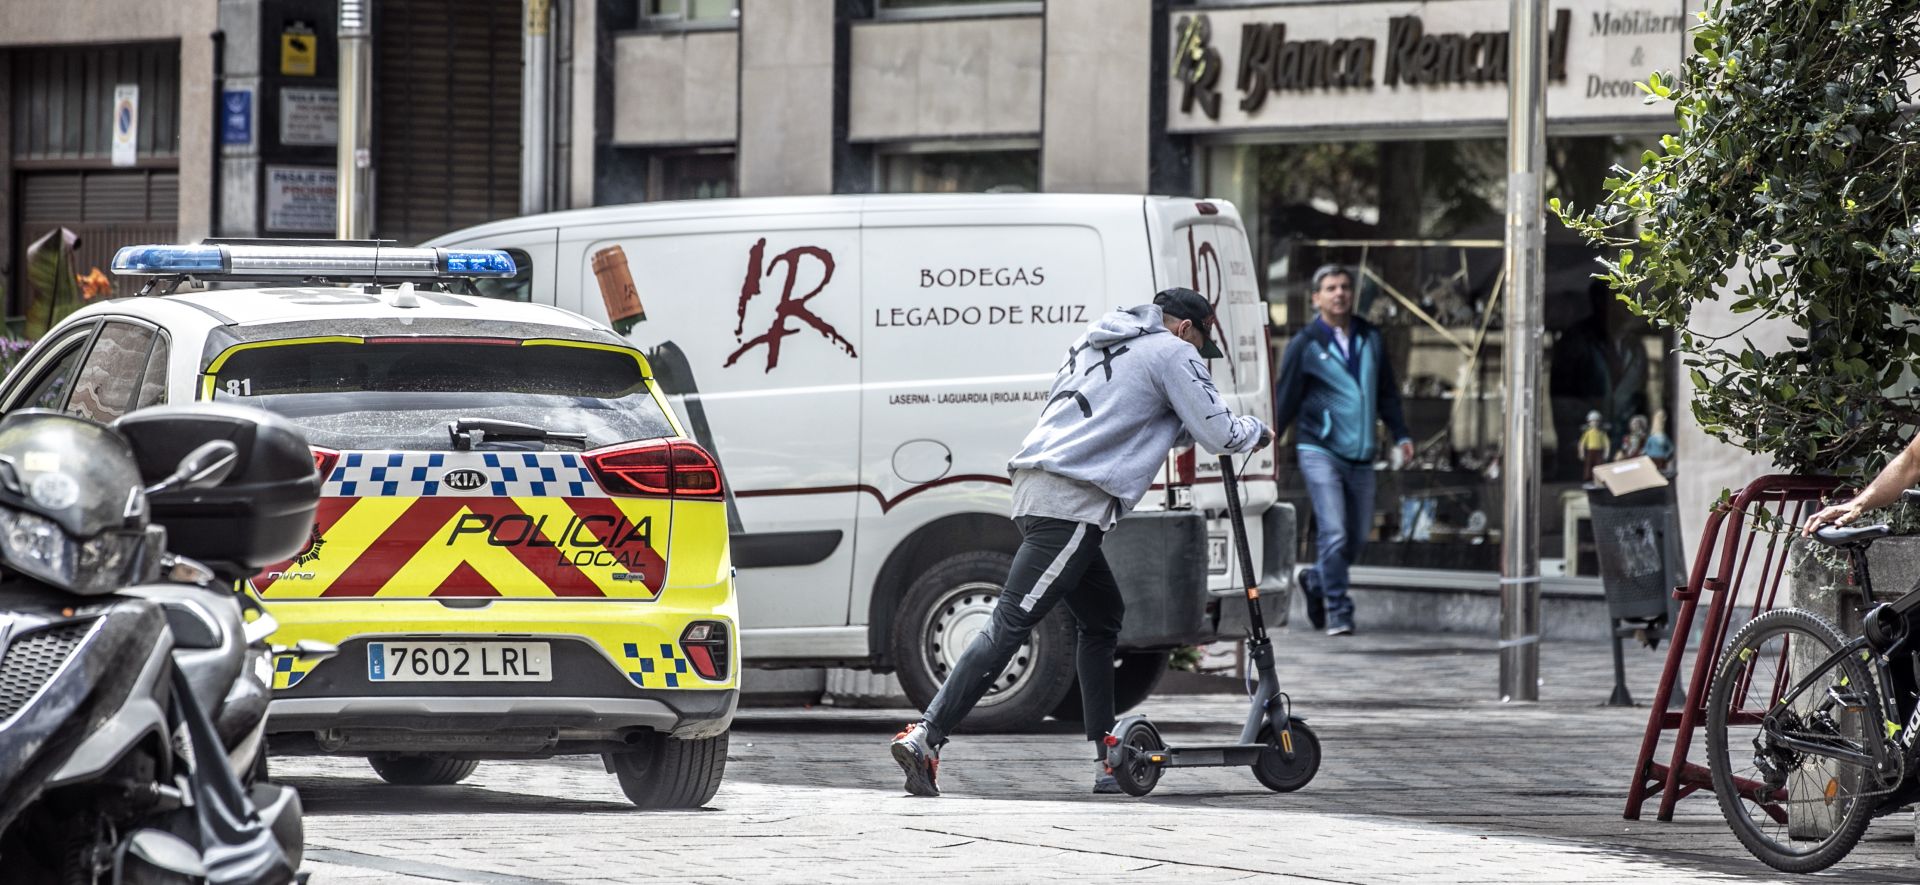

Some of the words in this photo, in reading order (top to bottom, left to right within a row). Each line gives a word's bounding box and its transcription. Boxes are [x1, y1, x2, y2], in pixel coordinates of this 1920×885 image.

[1630, 46, 1645, 67] &
[1238, 23, 1376, 116] Blanca
[919, 266, 1045, 288] BODEGAS
[875, 306, 982, 328] LEGADO
[989, 305, 1024, 326] DE
[1031, 304, 1089, 325] RUIZ
[225, 377, 251, 397] 81
[889, 393, 930, 404] LASERNA
[937, 392, 988, 404] LAGUARDIA
[990, 391, 1020, 405] (RIOJA
[450, 472, 482, 487] KIA
[446, 513, 652, 548] POLICIA
[557, 550, 646, 567] LOCAL
[374, 665, 381, 674] E
[390, 647, 470, 676] 7602
[481, 647, 540, 676] LRL
